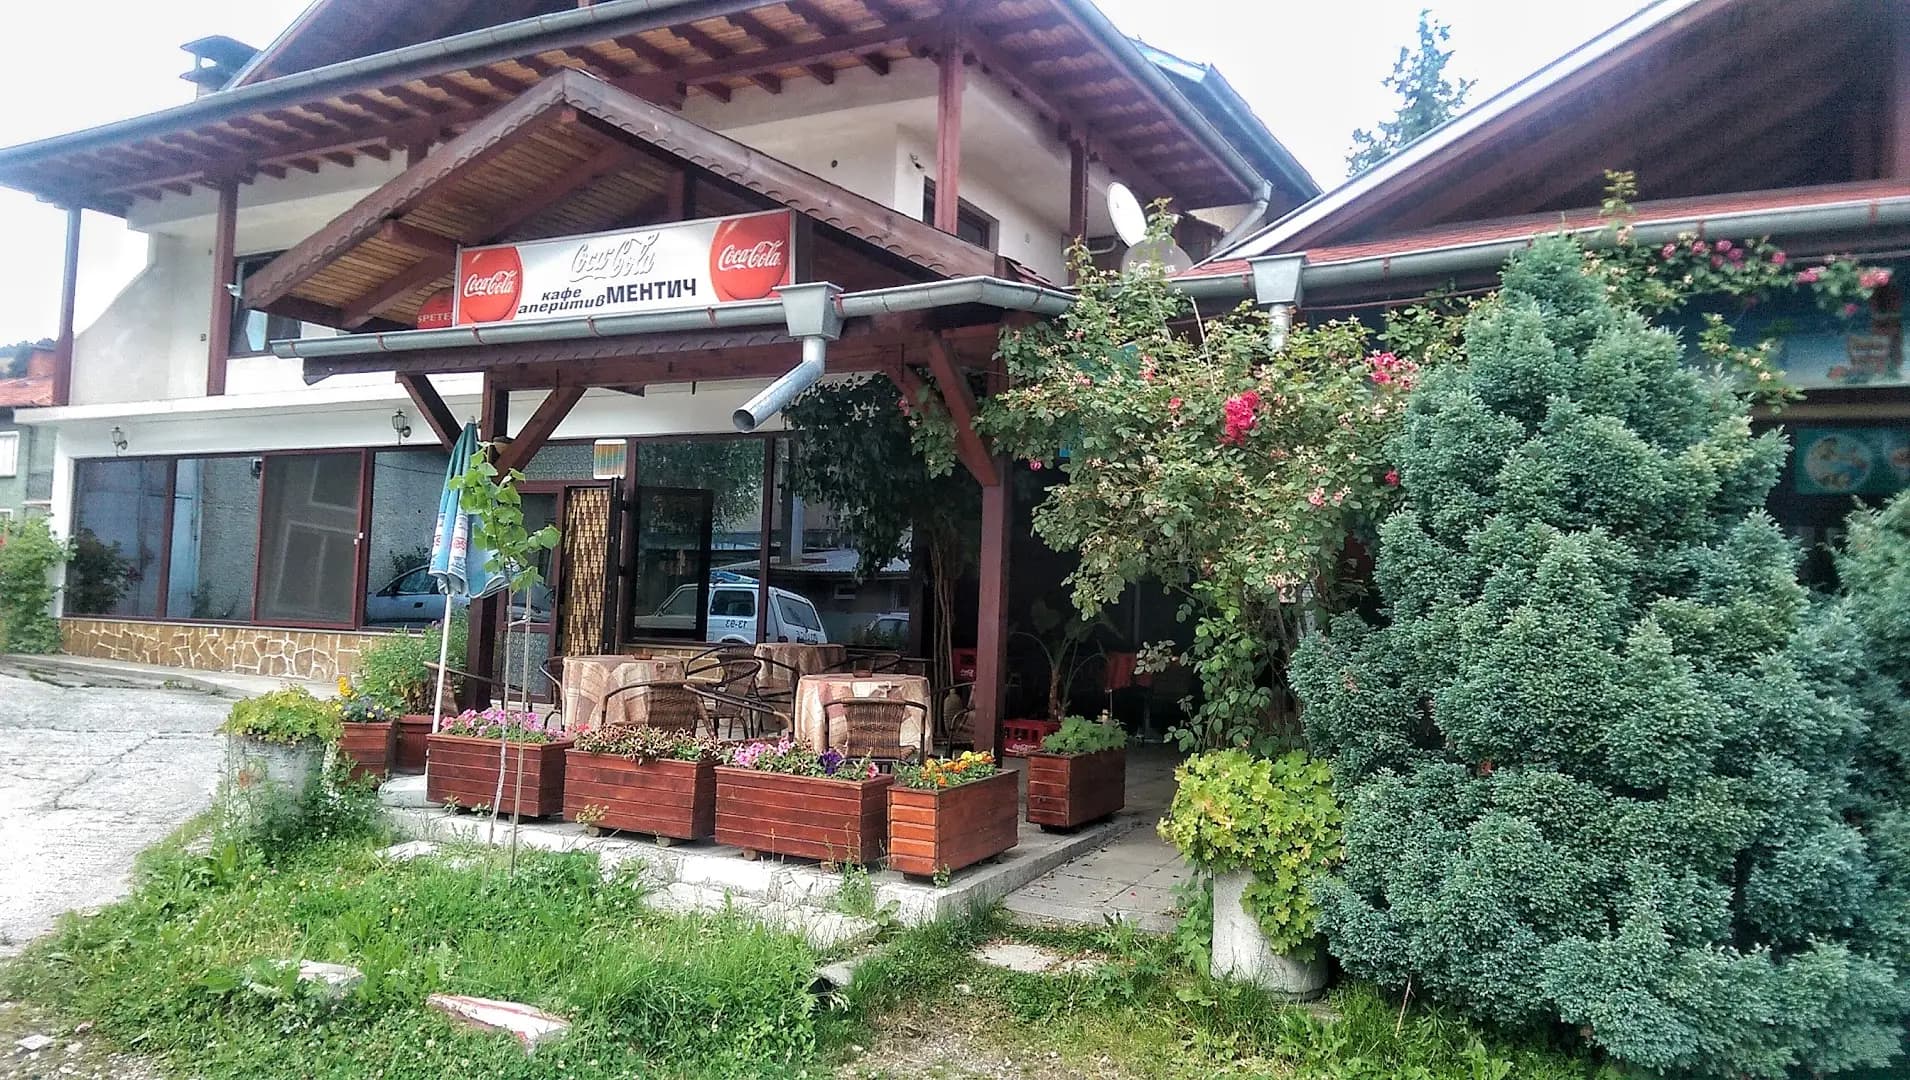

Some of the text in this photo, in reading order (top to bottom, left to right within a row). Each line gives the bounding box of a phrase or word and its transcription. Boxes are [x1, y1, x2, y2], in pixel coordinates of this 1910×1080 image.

[541, 287, 582, 302] кафе
[606, 278, 697, 305] МЕНТИЧ
[518, 294, 606, 315] аперитив
[417, 312, 452, 323] SPETE
